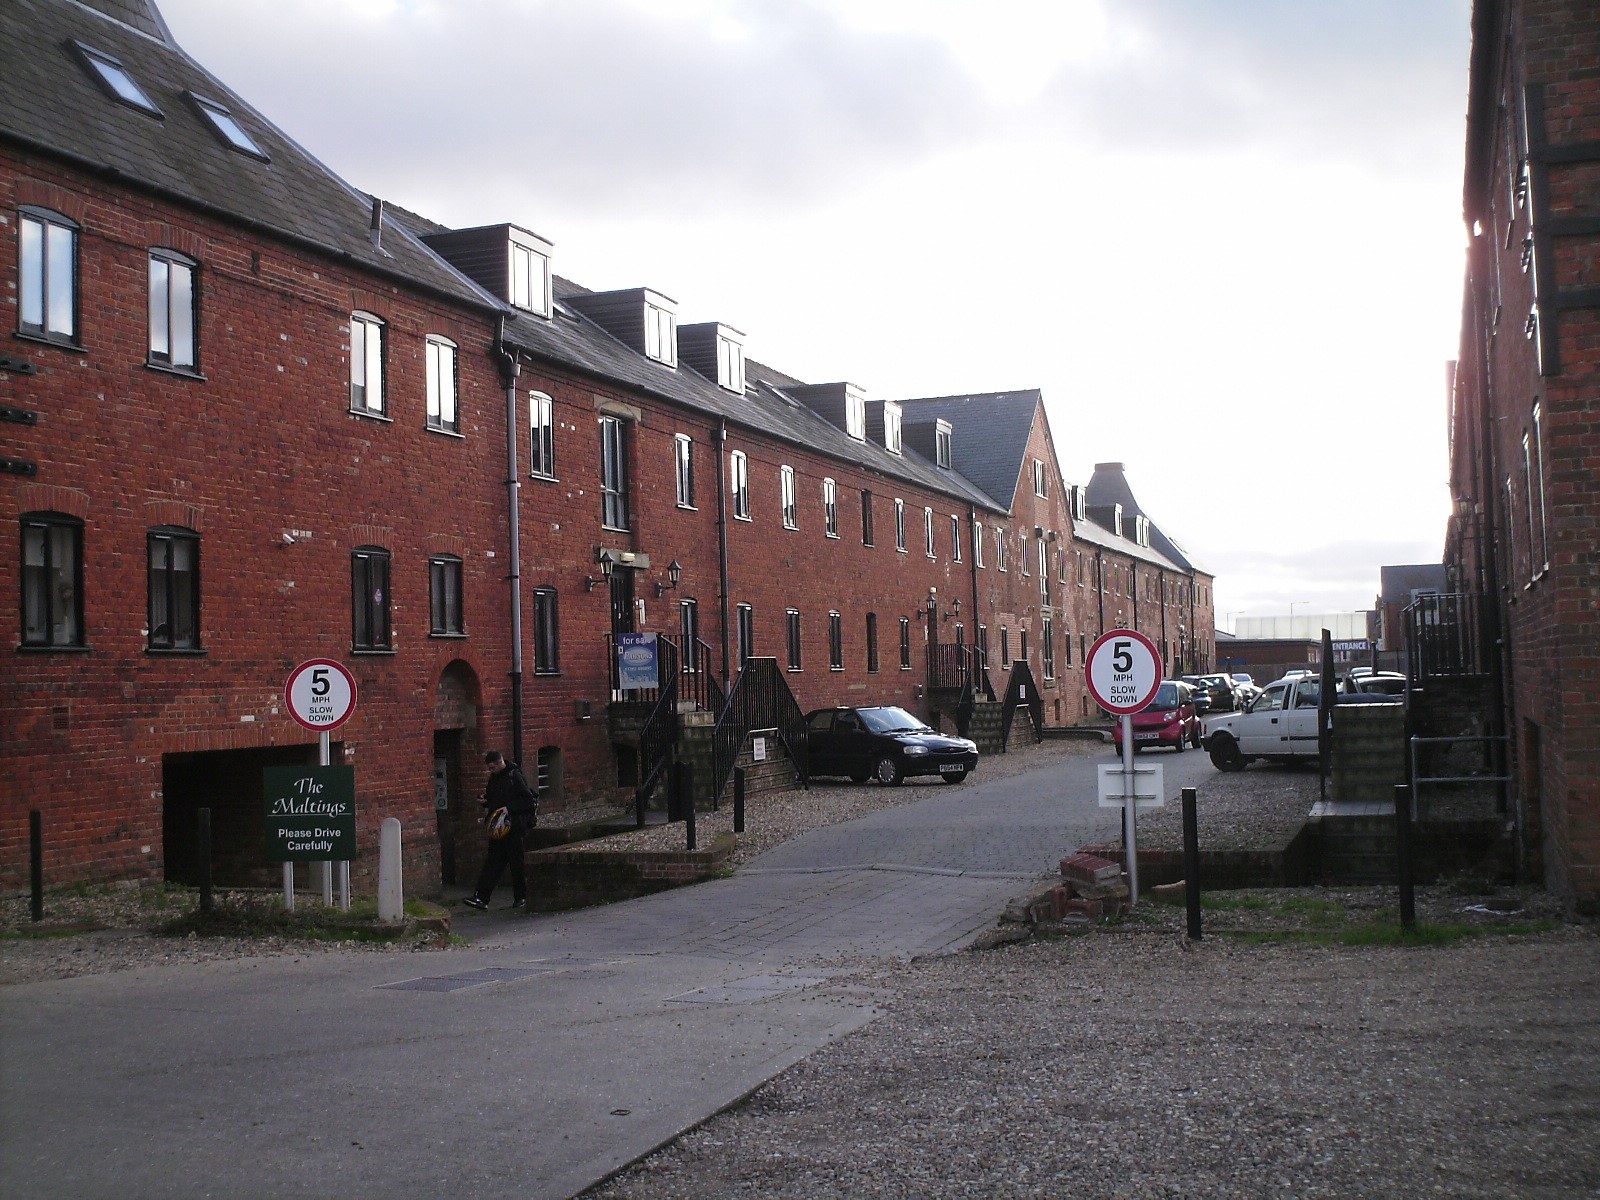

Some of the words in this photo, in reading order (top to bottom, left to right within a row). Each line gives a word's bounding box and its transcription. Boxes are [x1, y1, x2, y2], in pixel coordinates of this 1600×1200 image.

[623, 637, 633, 645] for
[1332, 641, 1366, 651] ENTRANCE
[1112, 641, 1133, 673] 5
[311, 669, 331, 696] 5
[1113, 674, 1133, 682] MPH
[1110, 686, 1136, 694] SLOW
[1110, 695, 1138, 703] DOWN
[309, 706, 333, 714] SLOW
[294, 777, 323, 794] The
[272, 797, 346, 818] Maltings
[278, 828, 312, 838] Please
[315, 827, 341, 837] Drive
[287, 841, 333, 852] Carefully
